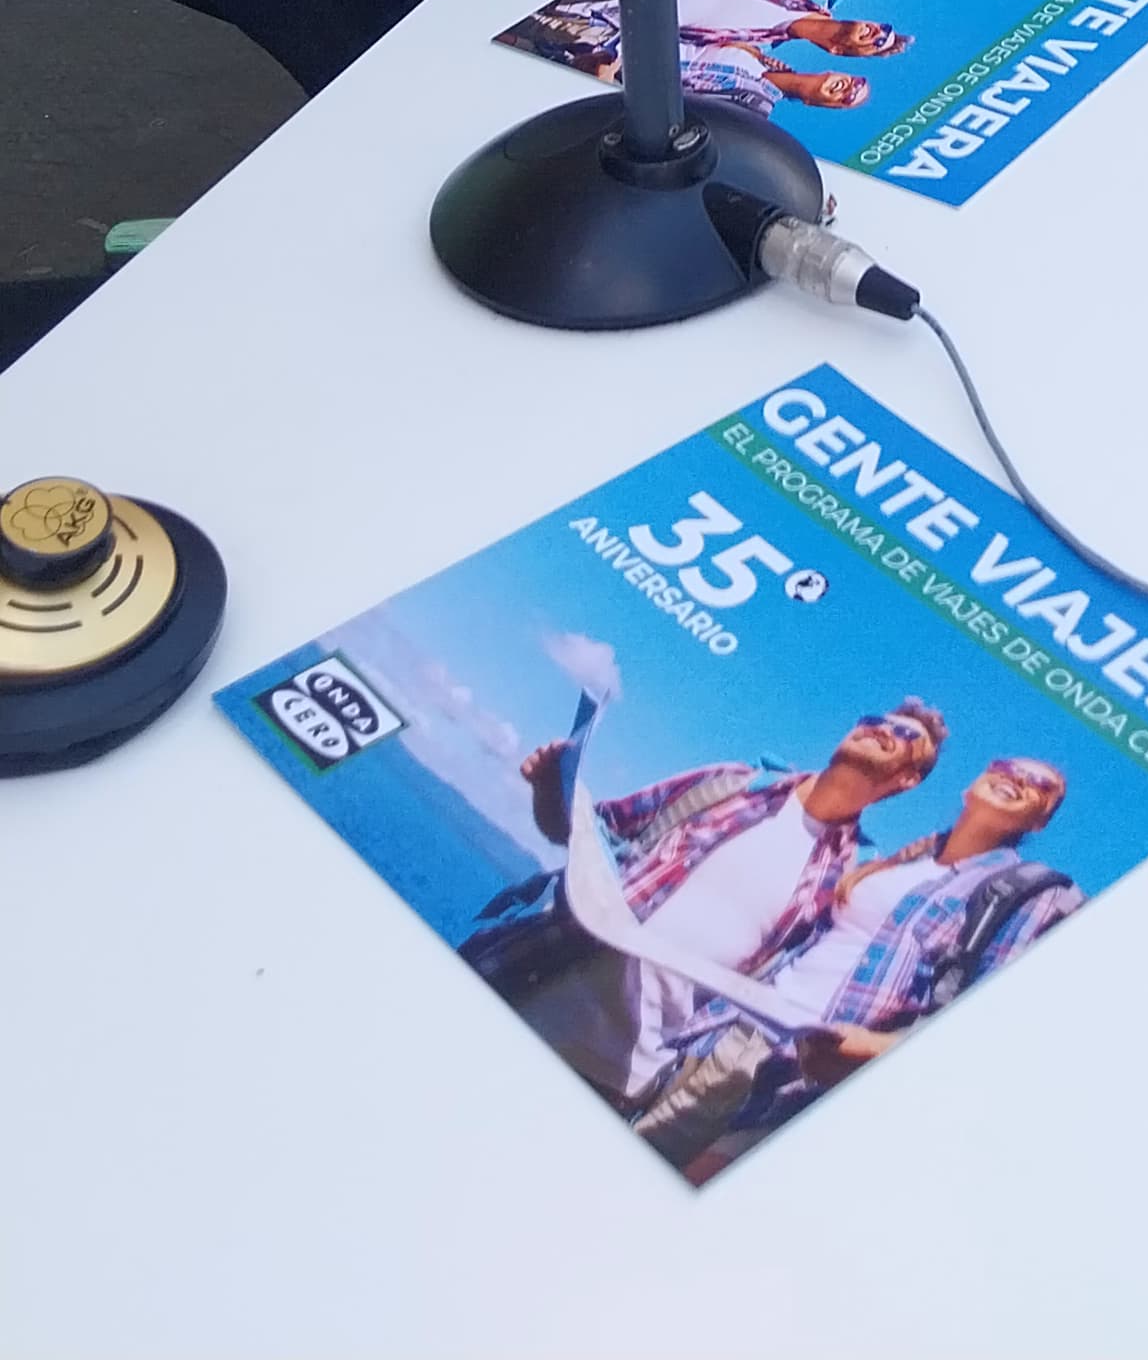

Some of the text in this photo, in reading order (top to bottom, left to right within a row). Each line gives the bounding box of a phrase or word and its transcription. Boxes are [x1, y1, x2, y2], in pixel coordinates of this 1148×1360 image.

[1033, 3, 1064, 26] DE
[982, 23, 1042, 65] VIAJES
[958, 61, 990, 85] DE
[889, 39, 1099, 179] VIAJERA
[907, 82, 964, 125] ONDA
[860, 123, 913, 165] CERO
[763, 388, 980, 552] GENTE
[56, 496, 95, 547] AKG
[568, 515, 738, 655] ANIVERSARIO
[722, 422, 748, 455] EL
[751, 447, 886, 556] PROGRAMA
[881, 545, 926, 583] DE
[922, 572, 1009, 646] VIAJES
[1002, 636, 1051, 675] DE
[1045, 668, 1131, 737] ONDA
[283, 697, 340, 748] CERO
[313, 674, 373, 732] ONDA
